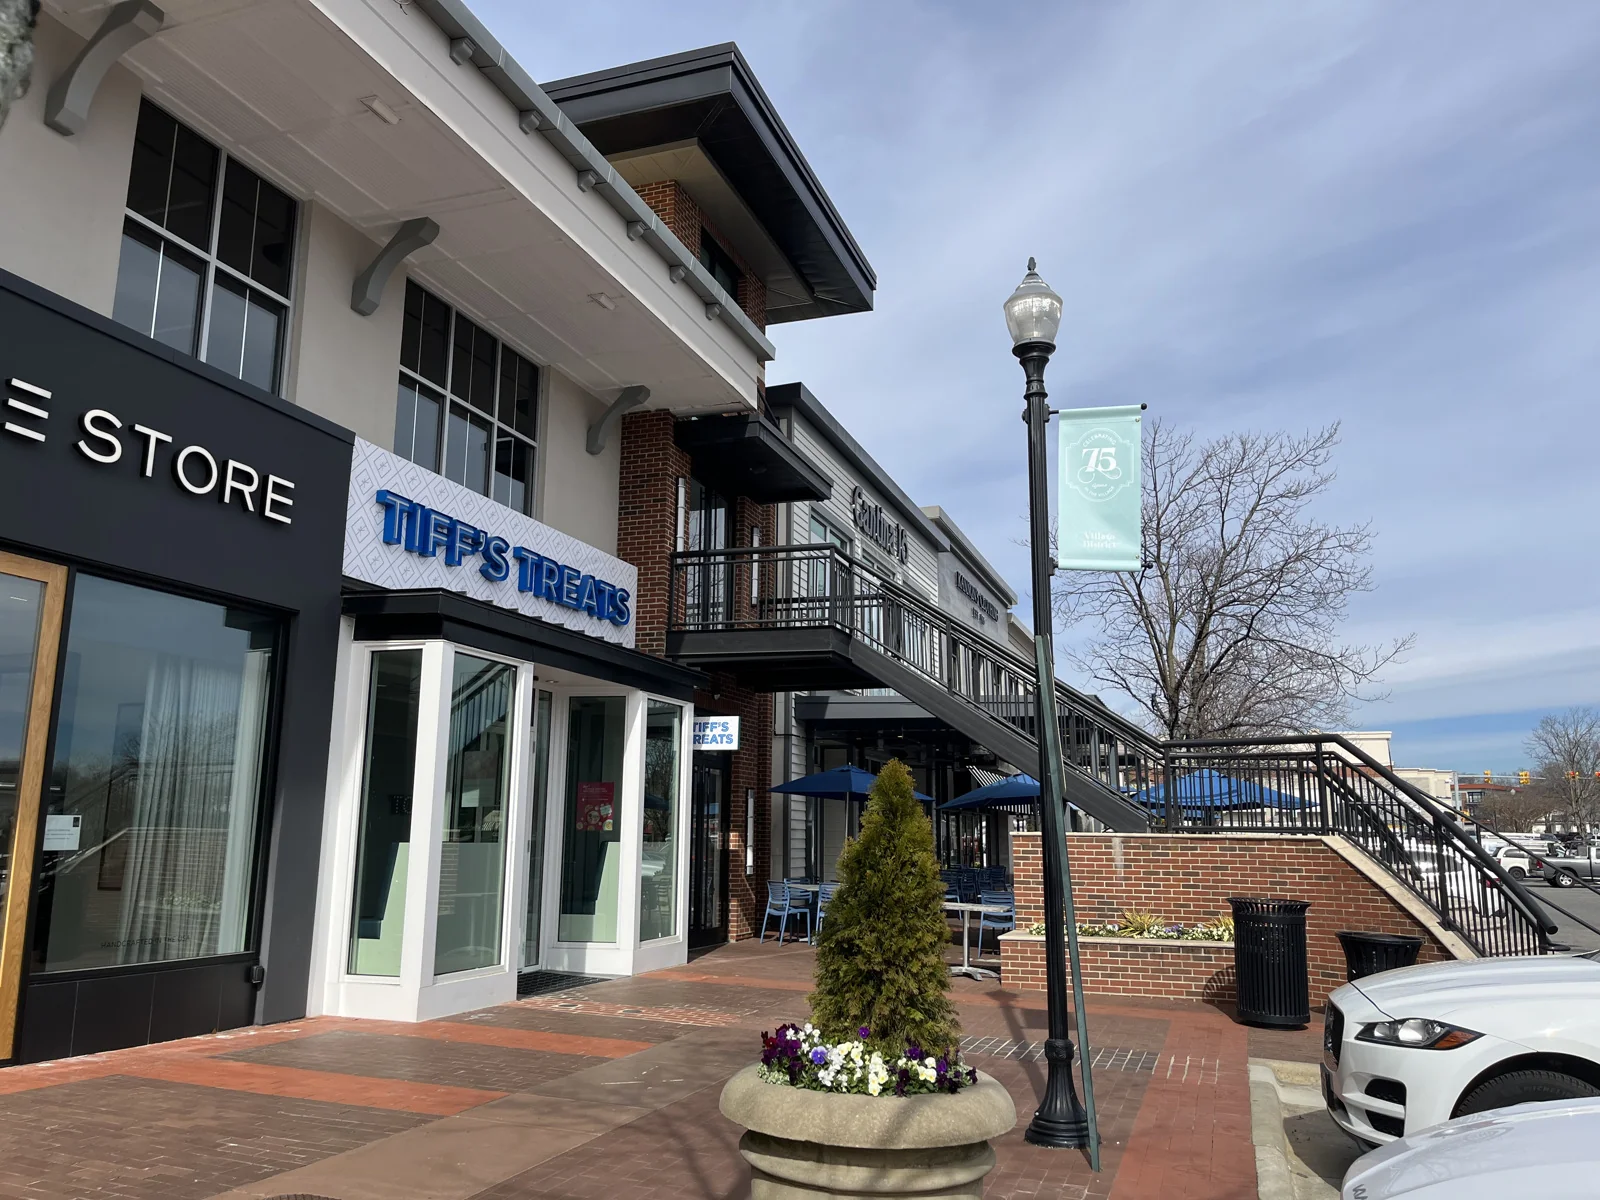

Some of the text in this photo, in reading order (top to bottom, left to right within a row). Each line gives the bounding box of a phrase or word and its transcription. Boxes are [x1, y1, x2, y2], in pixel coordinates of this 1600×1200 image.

[1082, 433, 1117, 448] CELEBRATING
[76, 408, 296, 525] STORE
[1081, 447, 1117, 473] 75
[852, 486, 896, 556] Cantina
[376, 489, 631, 626] TIFF'S TREATS
[693, 733, 733, 745] REATS
[100, 938, 154, 949] HANDCRAFTED
